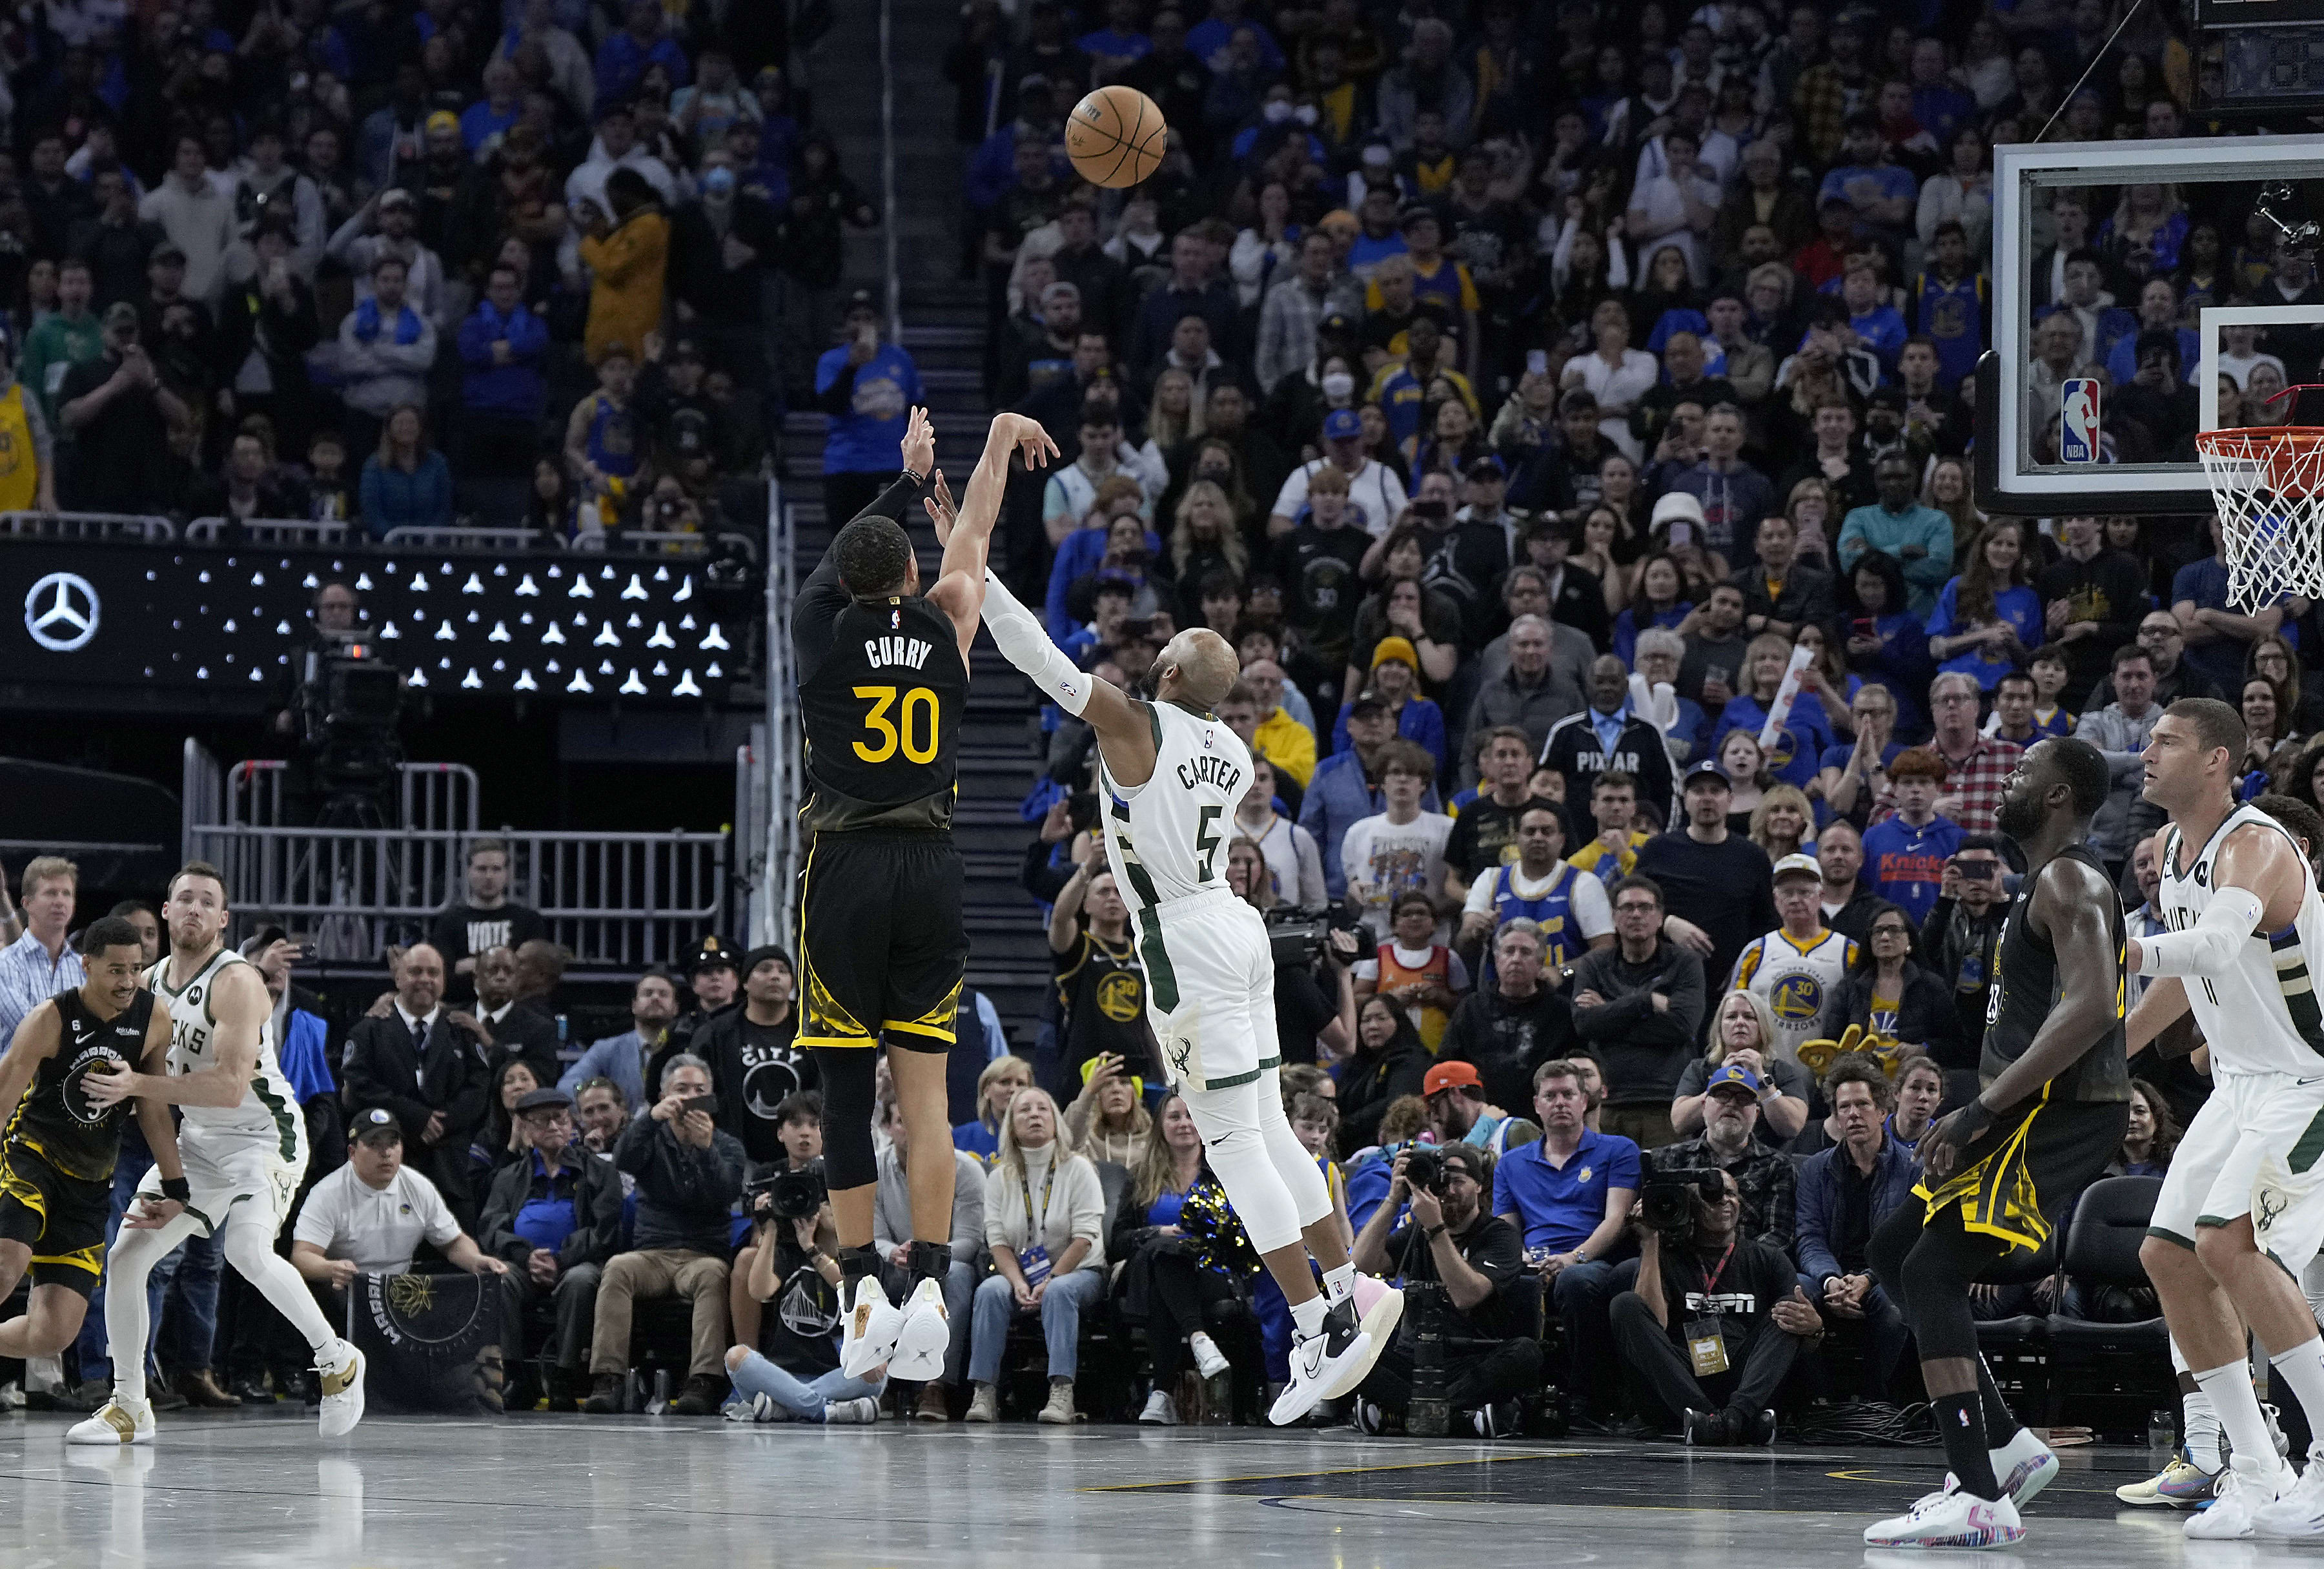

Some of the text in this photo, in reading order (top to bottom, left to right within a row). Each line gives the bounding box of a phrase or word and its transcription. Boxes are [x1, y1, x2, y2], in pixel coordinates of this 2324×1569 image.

[2067, 444, 2084, 458] NBA
[865, 636, 933, 670] CURRY
[852, 686, 939, 764] 30
[1177, 755, 1241, 795] CARTER
[1576, 751, 1640, 774] PIXAR
[1196, 805, 1223, 883] 5
[1797, 981, 1813, 996] 30
[1986, 983, 2000, 1019] 23
[742, 1047, 802, 1067] CITY
[1686, 1292, 1755, 1313] ESPN
